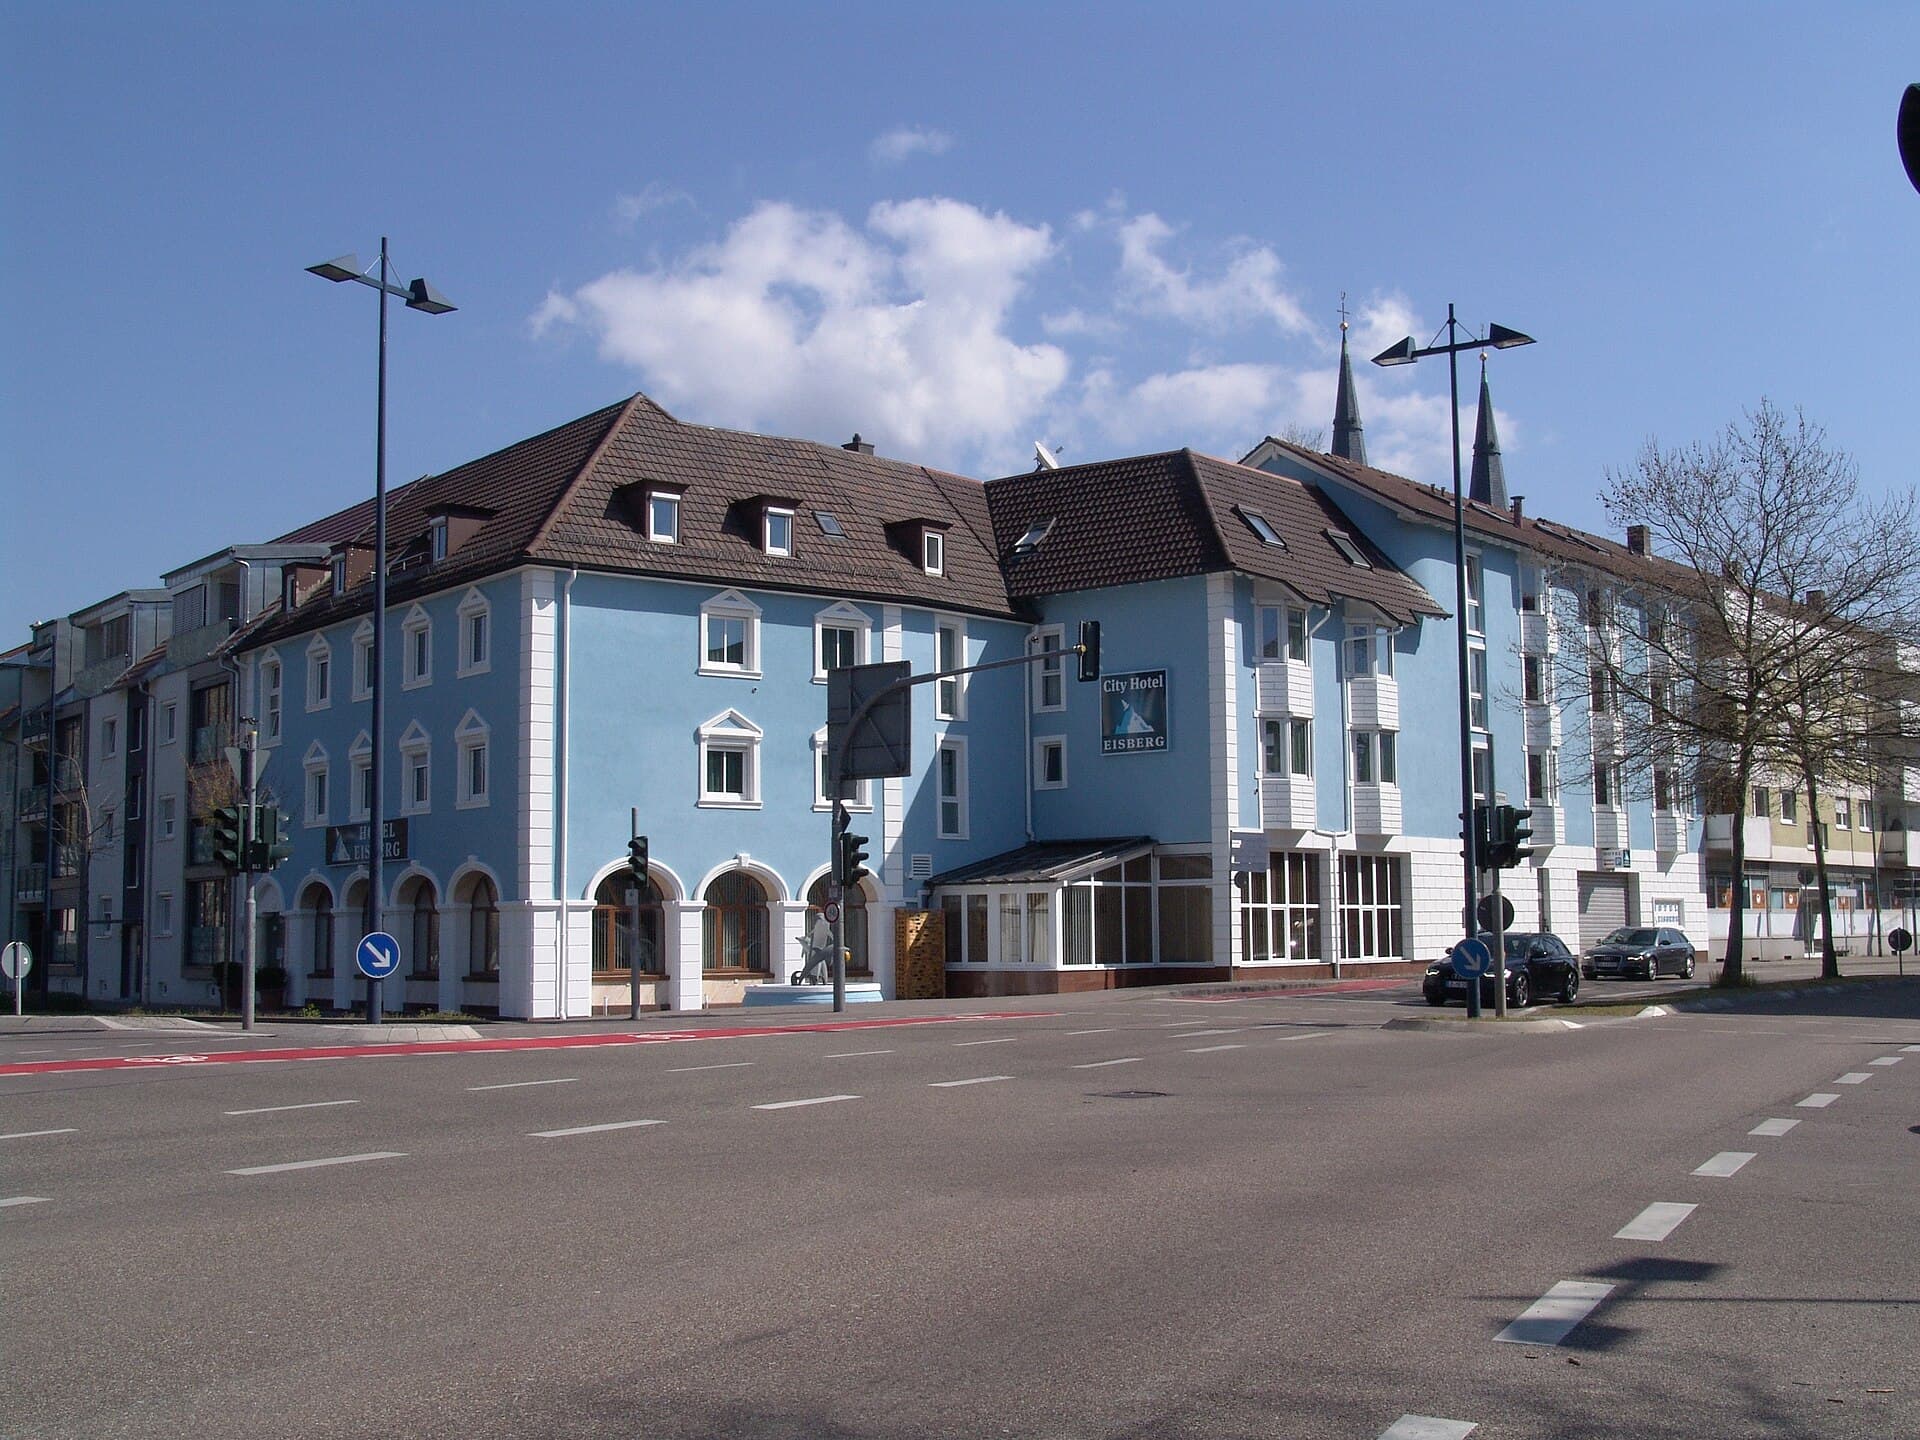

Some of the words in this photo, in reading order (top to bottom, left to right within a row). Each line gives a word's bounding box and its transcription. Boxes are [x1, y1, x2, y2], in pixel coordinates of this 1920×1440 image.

[1103, 679, 1128, 694] City
[1130, 674, 1164, 690] Hotel
[1103, 736, 1165, 751] EISBERG
[359, 822, 396, 841] HEL
[352, 841, 400, 860] EISRG
